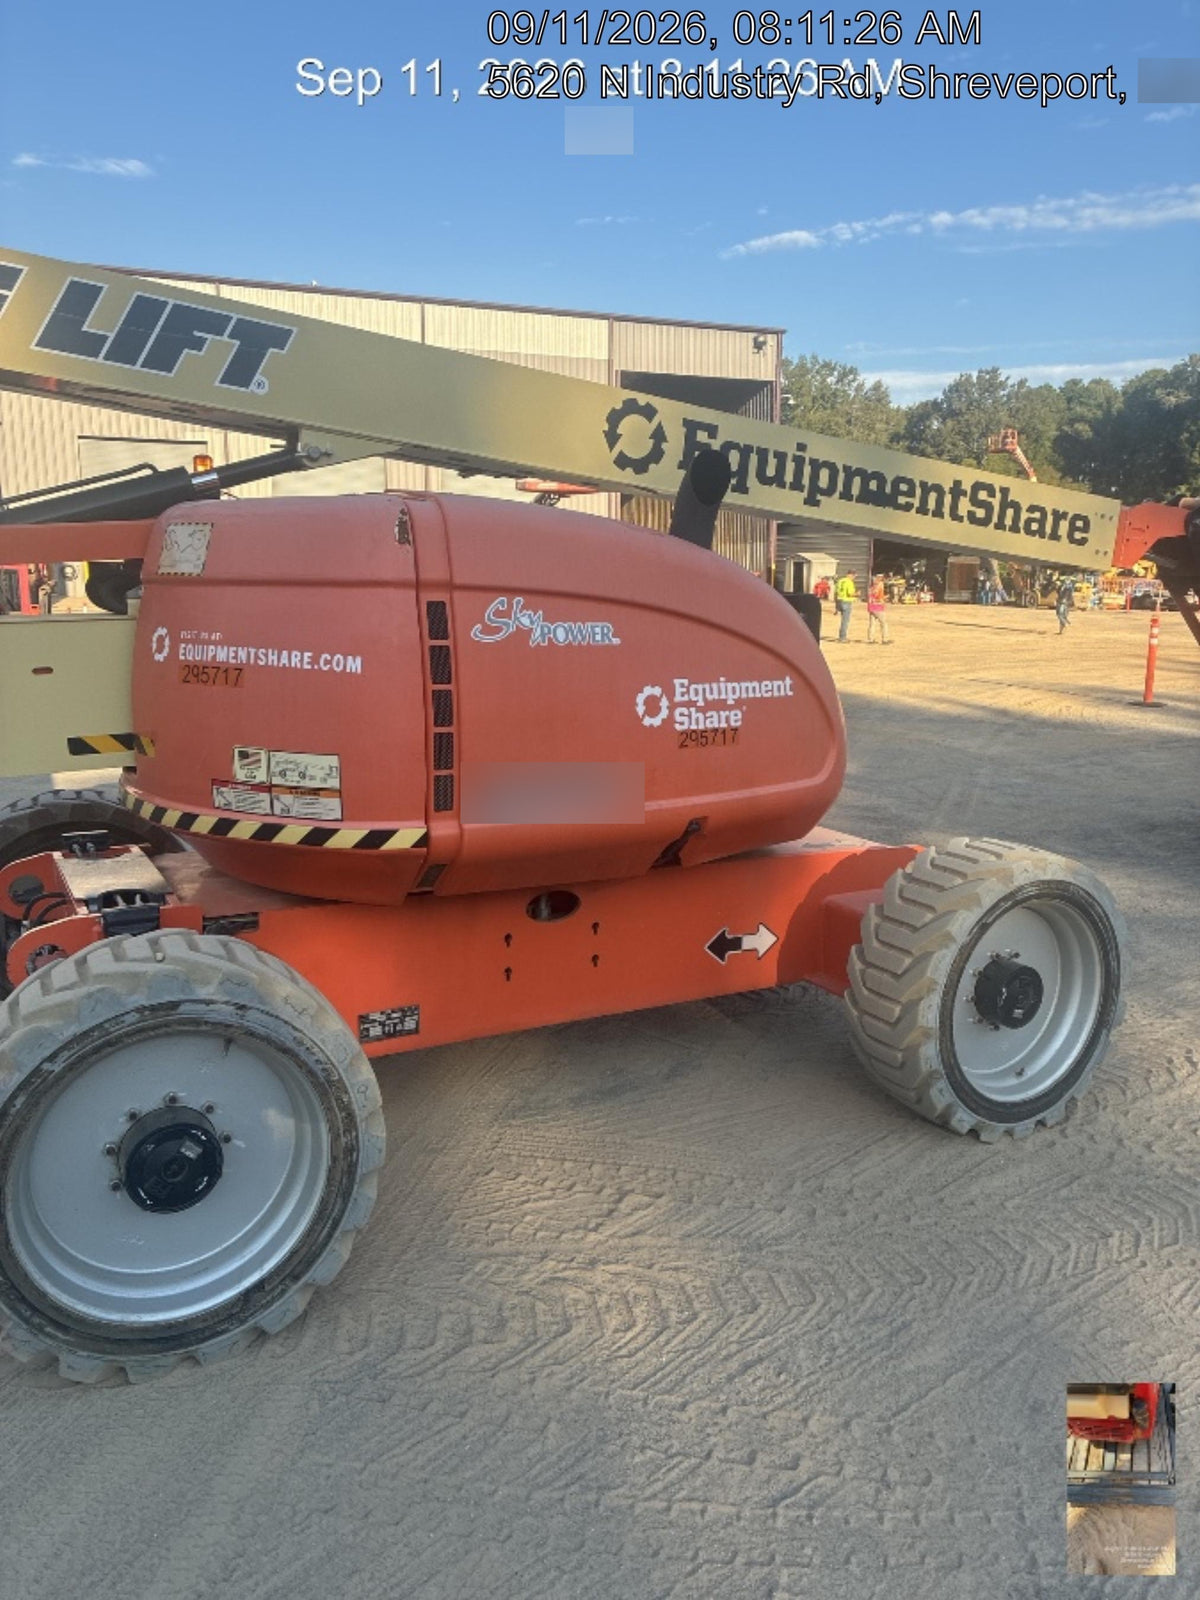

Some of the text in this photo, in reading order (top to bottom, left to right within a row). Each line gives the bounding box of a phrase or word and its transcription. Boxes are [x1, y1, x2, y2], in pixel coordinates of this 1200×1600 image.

[677, 417, 1090, 547] EquipmentShare
[178, 643, 363, 674] EQUIPMENTSHARE.COM
[181, 664, 244, 688] 295717
[673, 676, 794, 706] Equipment
[673, 706, 743, 731] Share
[678, 728, 738, 749] 295717
